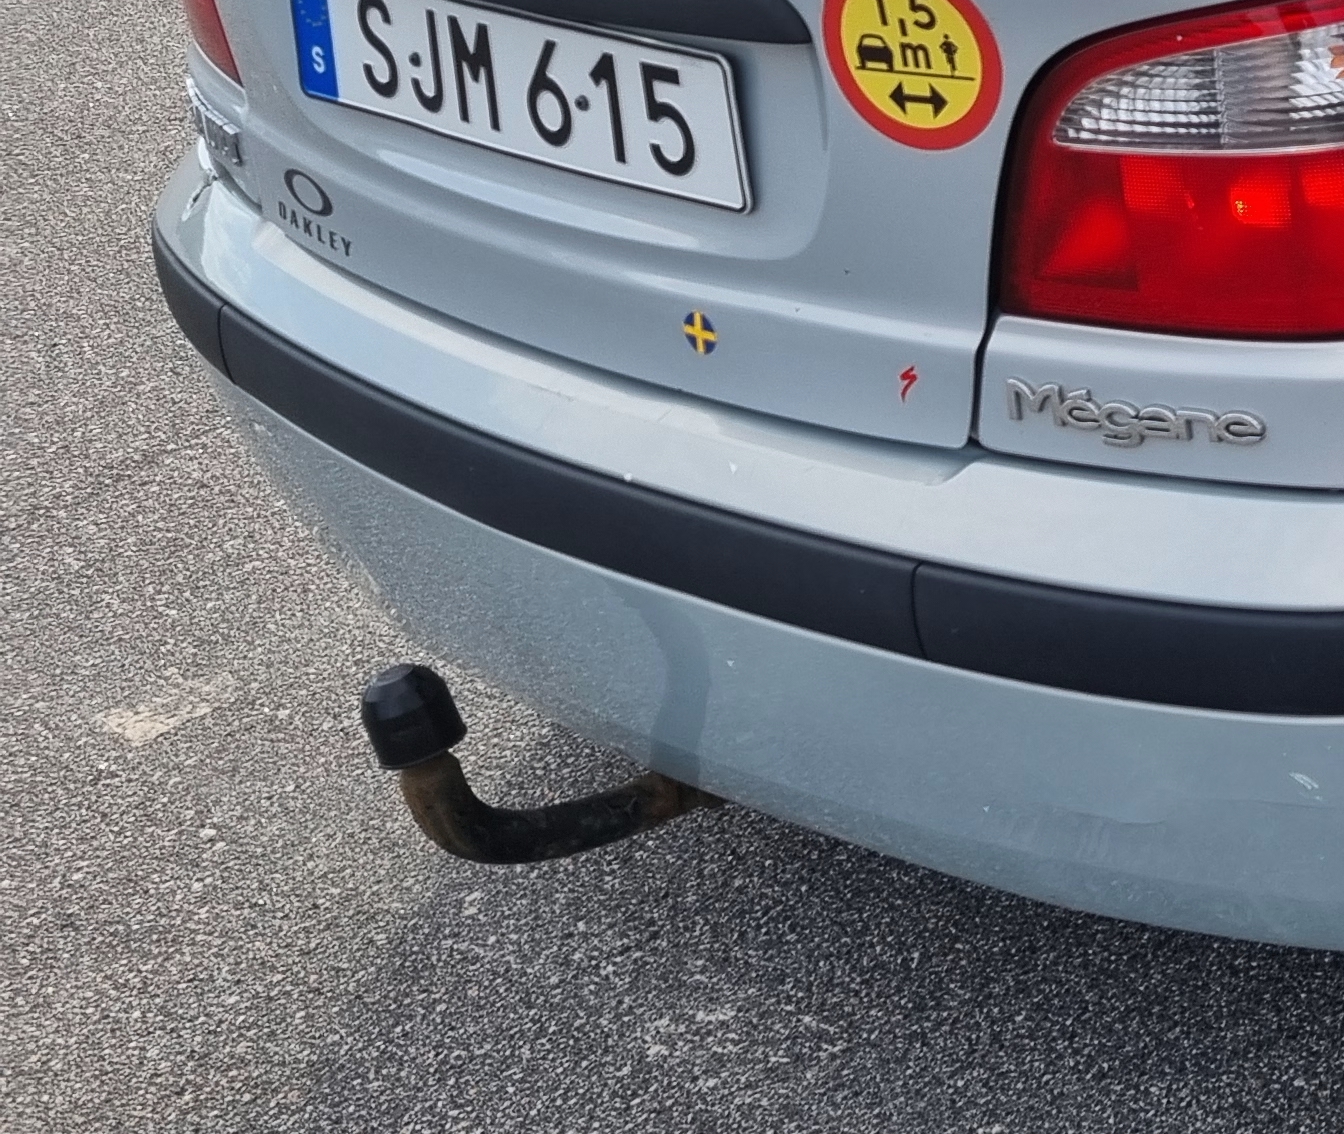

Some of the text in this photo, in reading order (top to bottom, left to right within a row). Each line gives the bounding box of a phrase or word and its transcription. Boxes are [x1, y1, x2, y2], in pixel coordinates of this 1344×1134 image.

[311, 43, 326, 74] S
[900, 40, 932, 70] m
[277, 200, 353, 258] OAKLEY
[1006, 375, 1268, 447] Mégane
